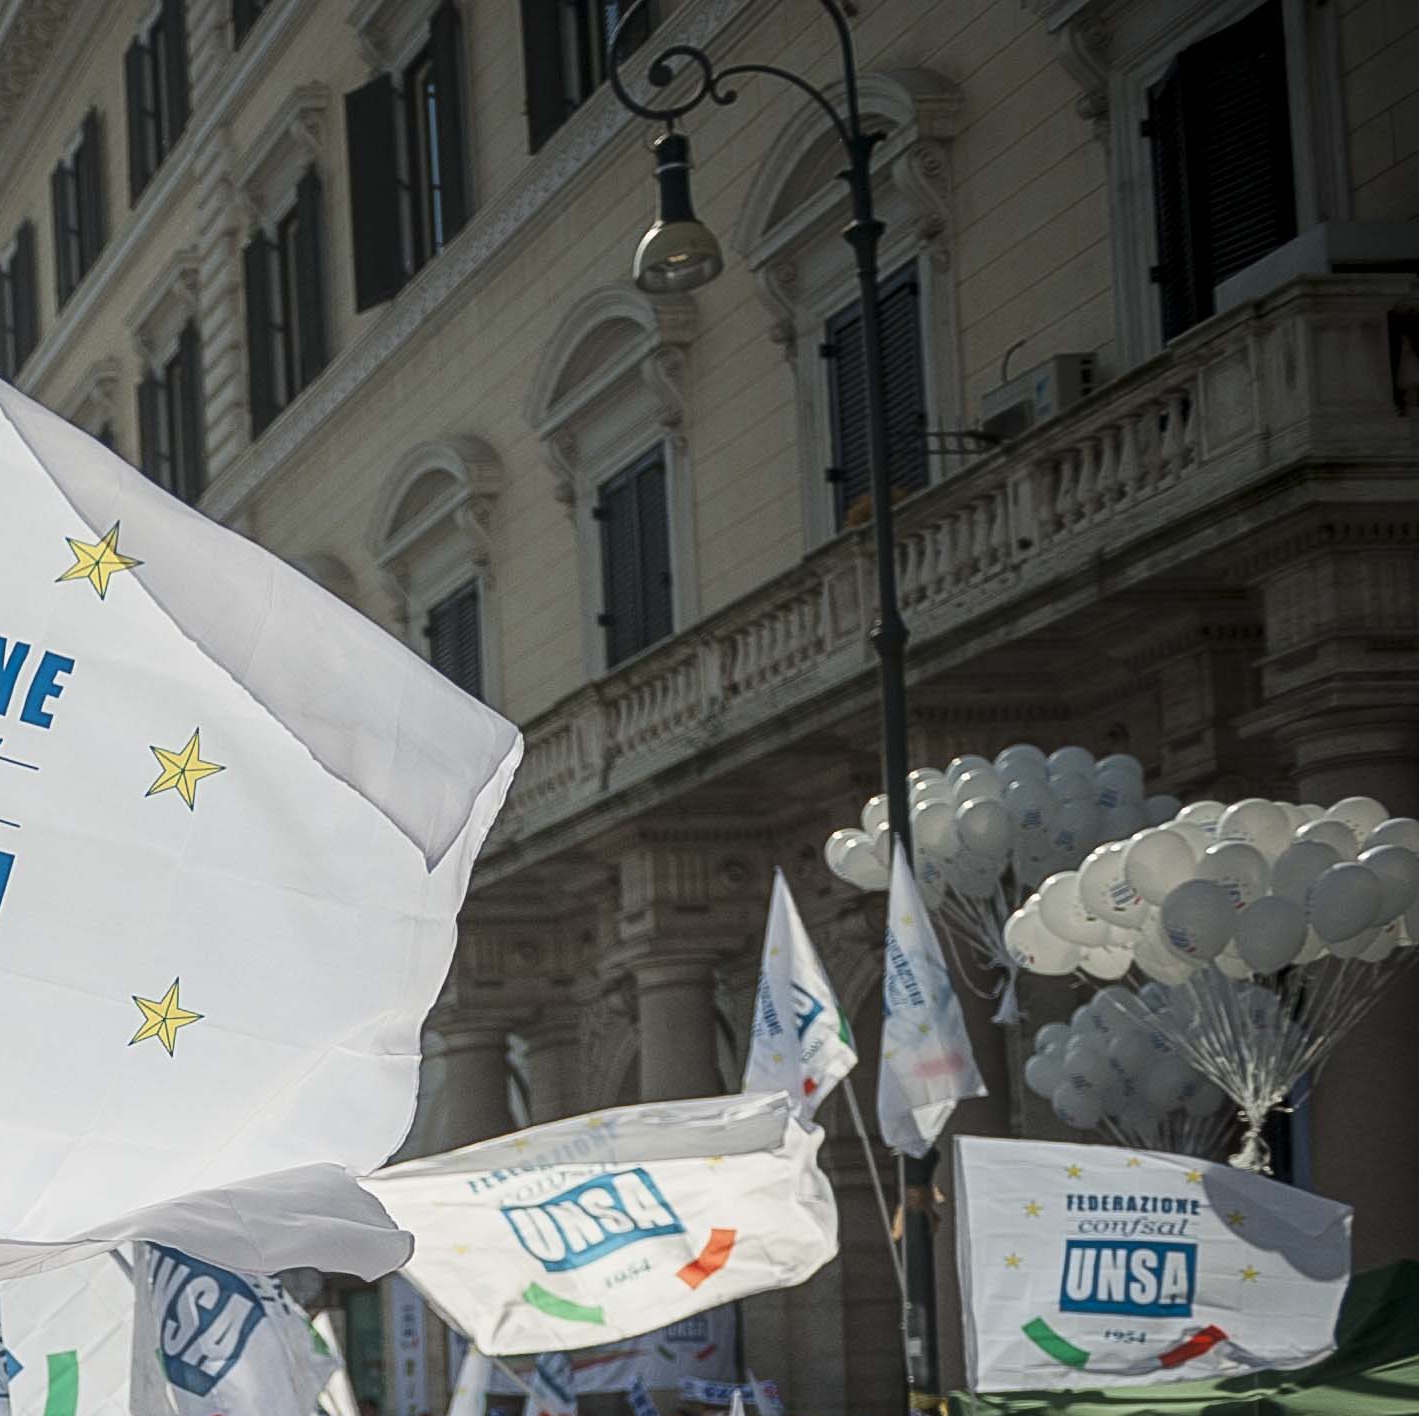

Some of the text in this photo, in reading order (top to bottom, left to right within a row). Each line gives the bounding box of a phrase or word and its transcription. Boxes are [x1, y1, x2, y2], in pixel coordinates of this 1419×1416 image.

[1067, 1193, 1201, 1215] FEDERAZIONE
[508, 1174, 676, 1263] UNSA
[1078, 1216, 1190, 1238] confsal
[604, 1262, 652, 1288] 1954
[1066, 1246, 1192, 1305] UNSA
[1104, 1329, 1146, 1345] 1954
